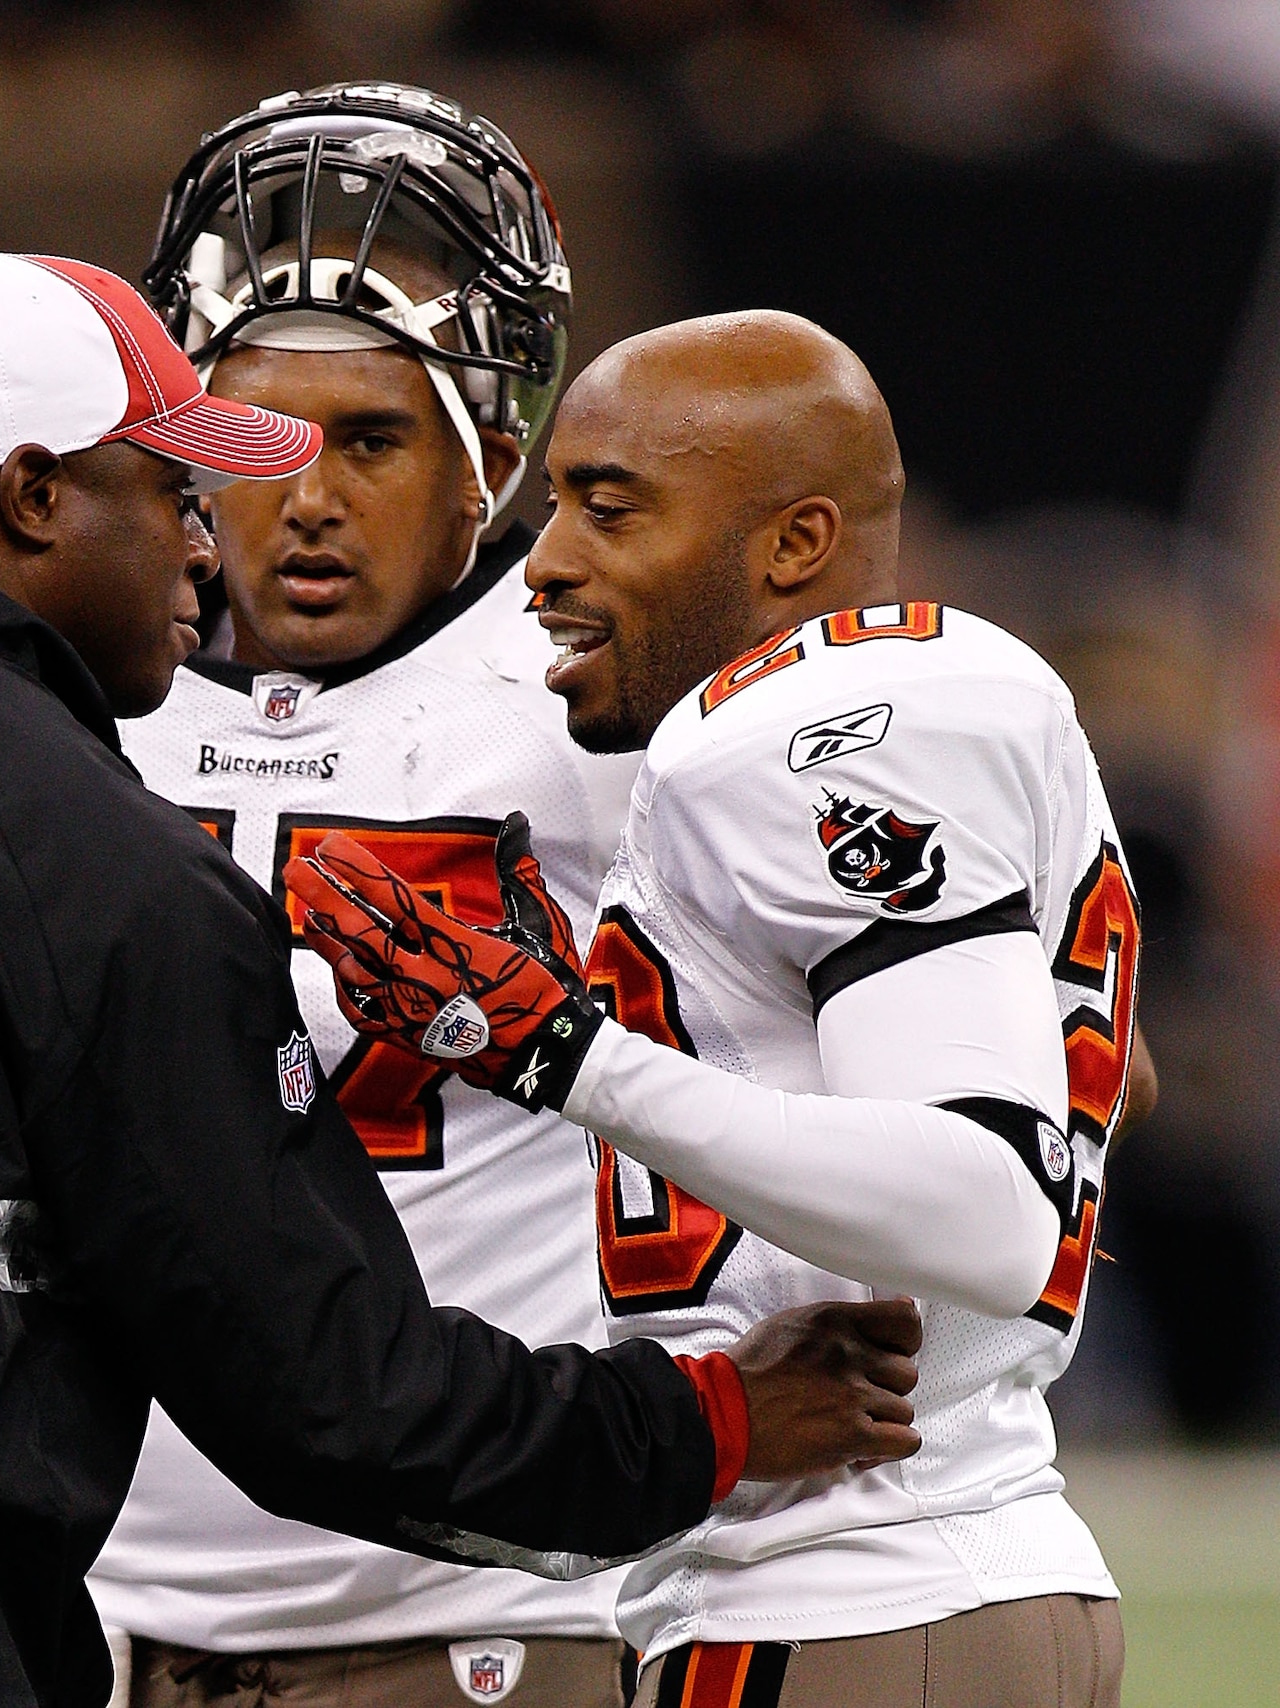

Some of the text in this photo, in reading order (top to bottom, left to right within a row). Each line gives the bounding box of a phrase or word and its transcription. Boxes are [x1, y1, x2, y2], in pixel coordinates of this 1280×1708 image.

[423, 997, 467, 1053] EQUIPMENT
[454, 1022, 485, 1053] NFL
[283, 1064, 313, 1104] NFL
